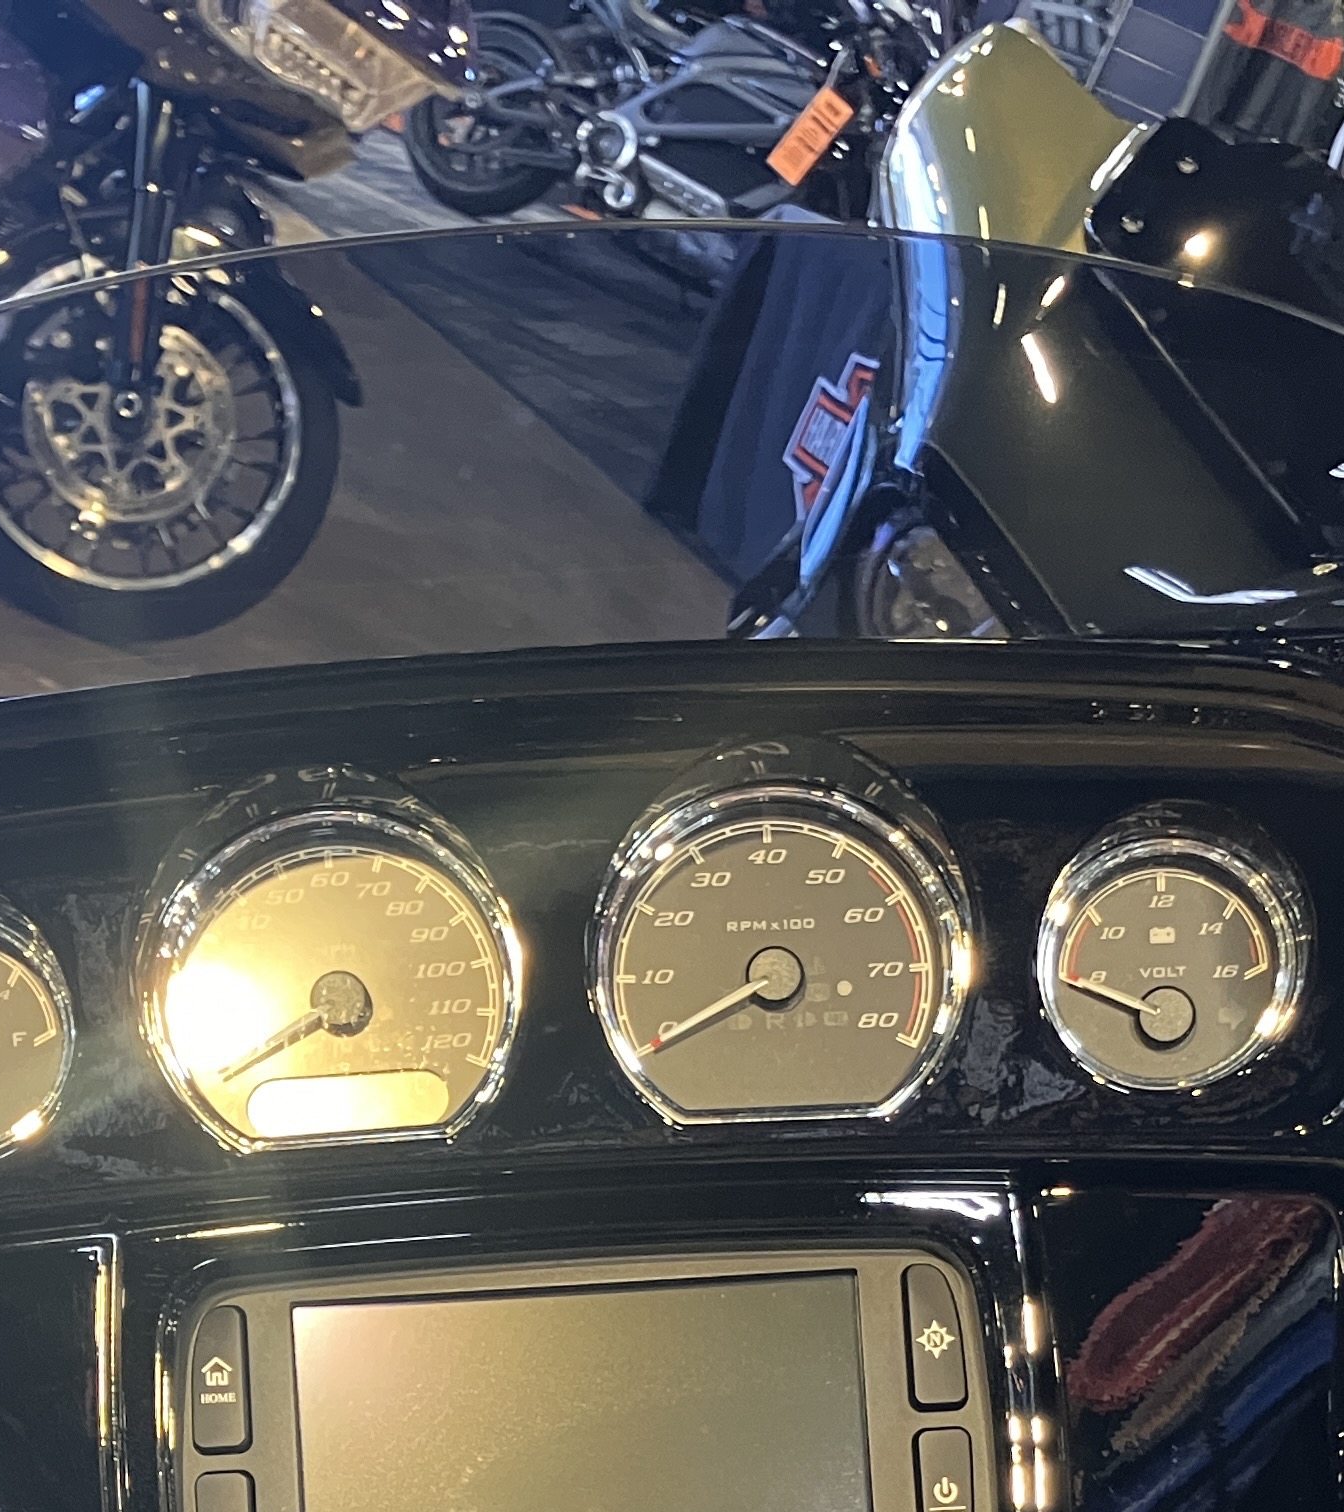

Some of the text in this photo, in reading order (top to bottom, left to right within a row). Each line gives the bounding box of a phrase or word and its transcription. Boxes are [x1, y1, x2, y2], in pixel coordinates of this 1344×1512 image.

[748, 849, 787, 865] 40
[310, 872, 349, 887] 60
[690, 872, 731, 888] 30
[805, 869, 846, 885] 50
[265, 889, 304, 905] 50
[355, 881, 391, 899] 70
[386, 900, 424, 916] 80
[1148, 895, 1175, 908] 12
[654, 911, 694, 927] 20
[844, 907, 885, 923] 60
[409, 926, 449, 943] 90
[1100, 927, 1125, 940] 10
[1198, 922, 1223, 935] 14
[415, 961, 466, 979] 100
[642, 969, 675, 985] 10
[868, 962, 904, 978] 70
[1089, 971, 1106, 984] 8
[1139, 966, 1186, 978] VOLT
[1212, 965, 1239, 978] 16
[428, 999, 471, 1016] 110
[858, 1012, 899, 1029] 80
[12, 1032, 27, 1047] F
[423, 1033, 472, 1050] 120
[200, 1391, 237, 1404] HOME
